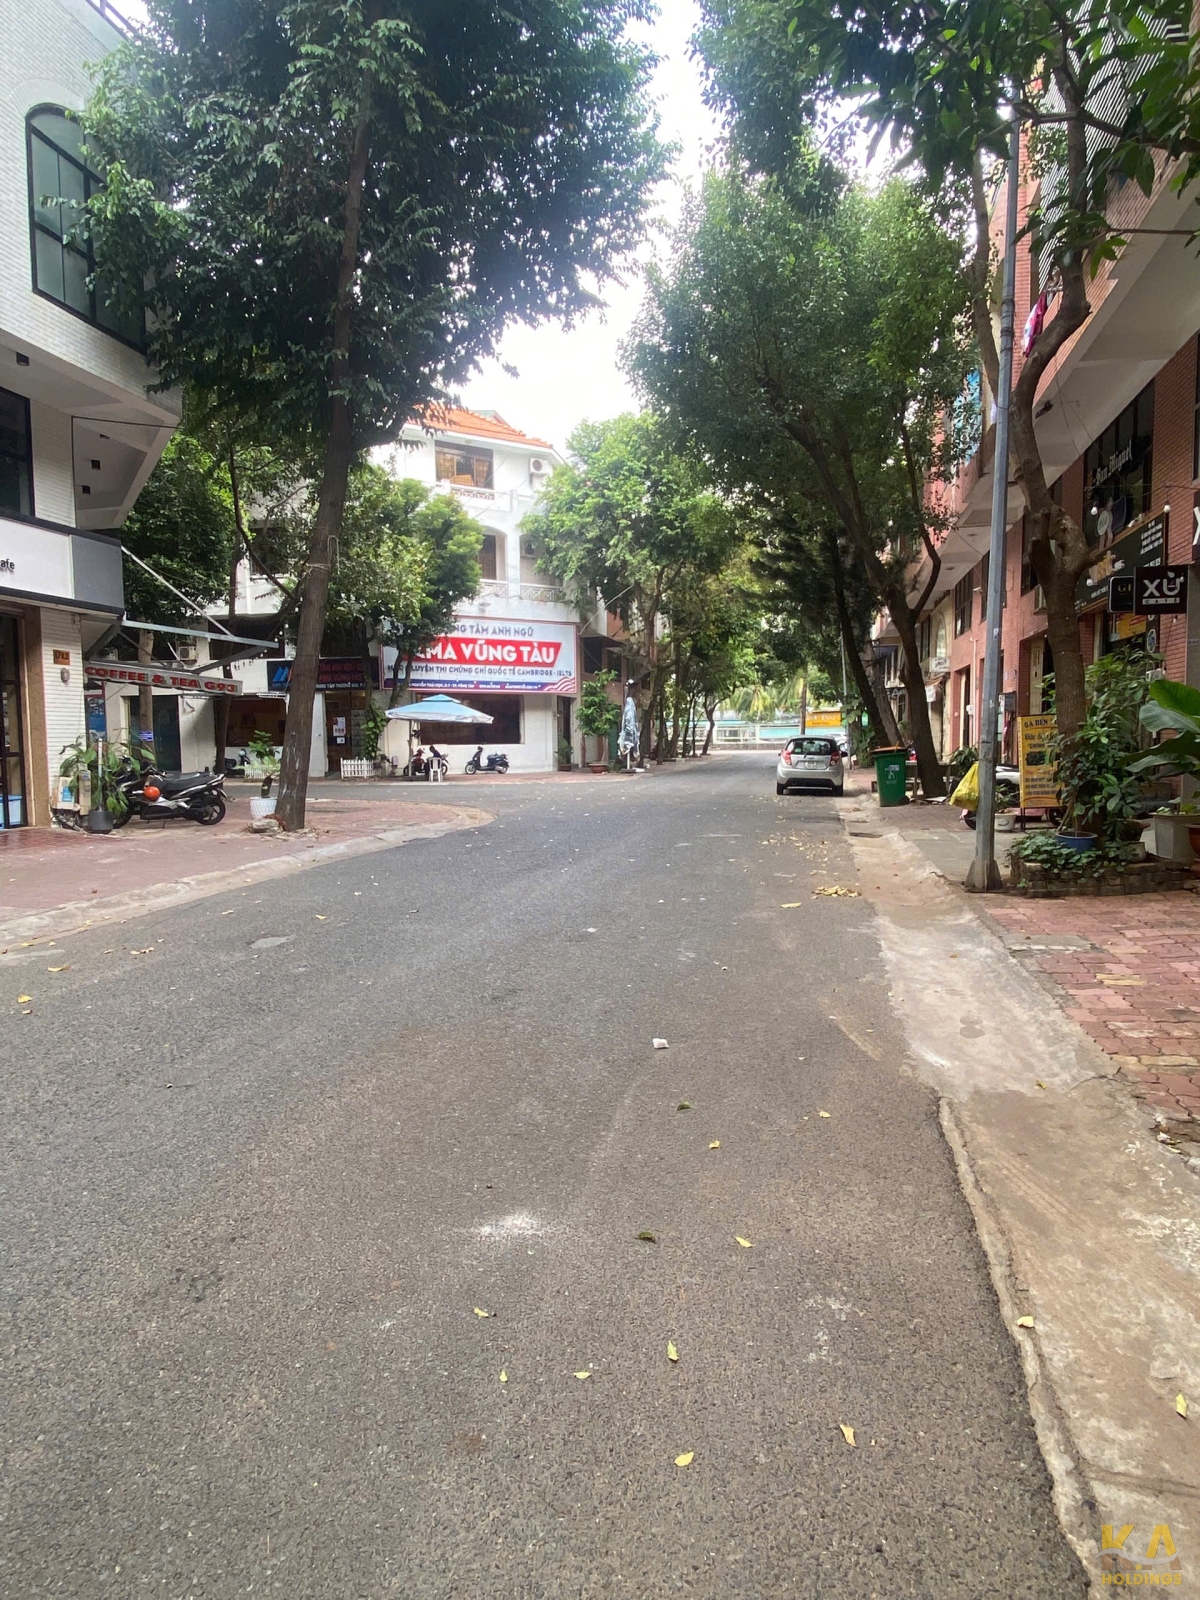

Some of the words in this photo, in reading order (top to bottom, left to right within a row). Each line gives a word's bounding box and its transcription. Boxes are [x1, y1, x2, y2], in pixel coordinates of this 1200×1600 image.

[0, 558, 15, 570] afe
[469, 623, 489, 635] TÂM
[491, 626, 511, 637] ANH
[514, 626, 534, 637] NGỮ
[460, 640, 517, 663] VŨNG
[519, 641, 555, 664] TÀU
[449, 665, 473, 674] CHỨNG
[487, 666, 507, 675] QUỐC
[517, 668, 553, 676] CAMBRIDGE
[85, 666, 148, 682] COFFEE
[152, 674, 166, 684] &
[170, 676, 199, 688] TEA
[204, 681, 238, 693] G93
